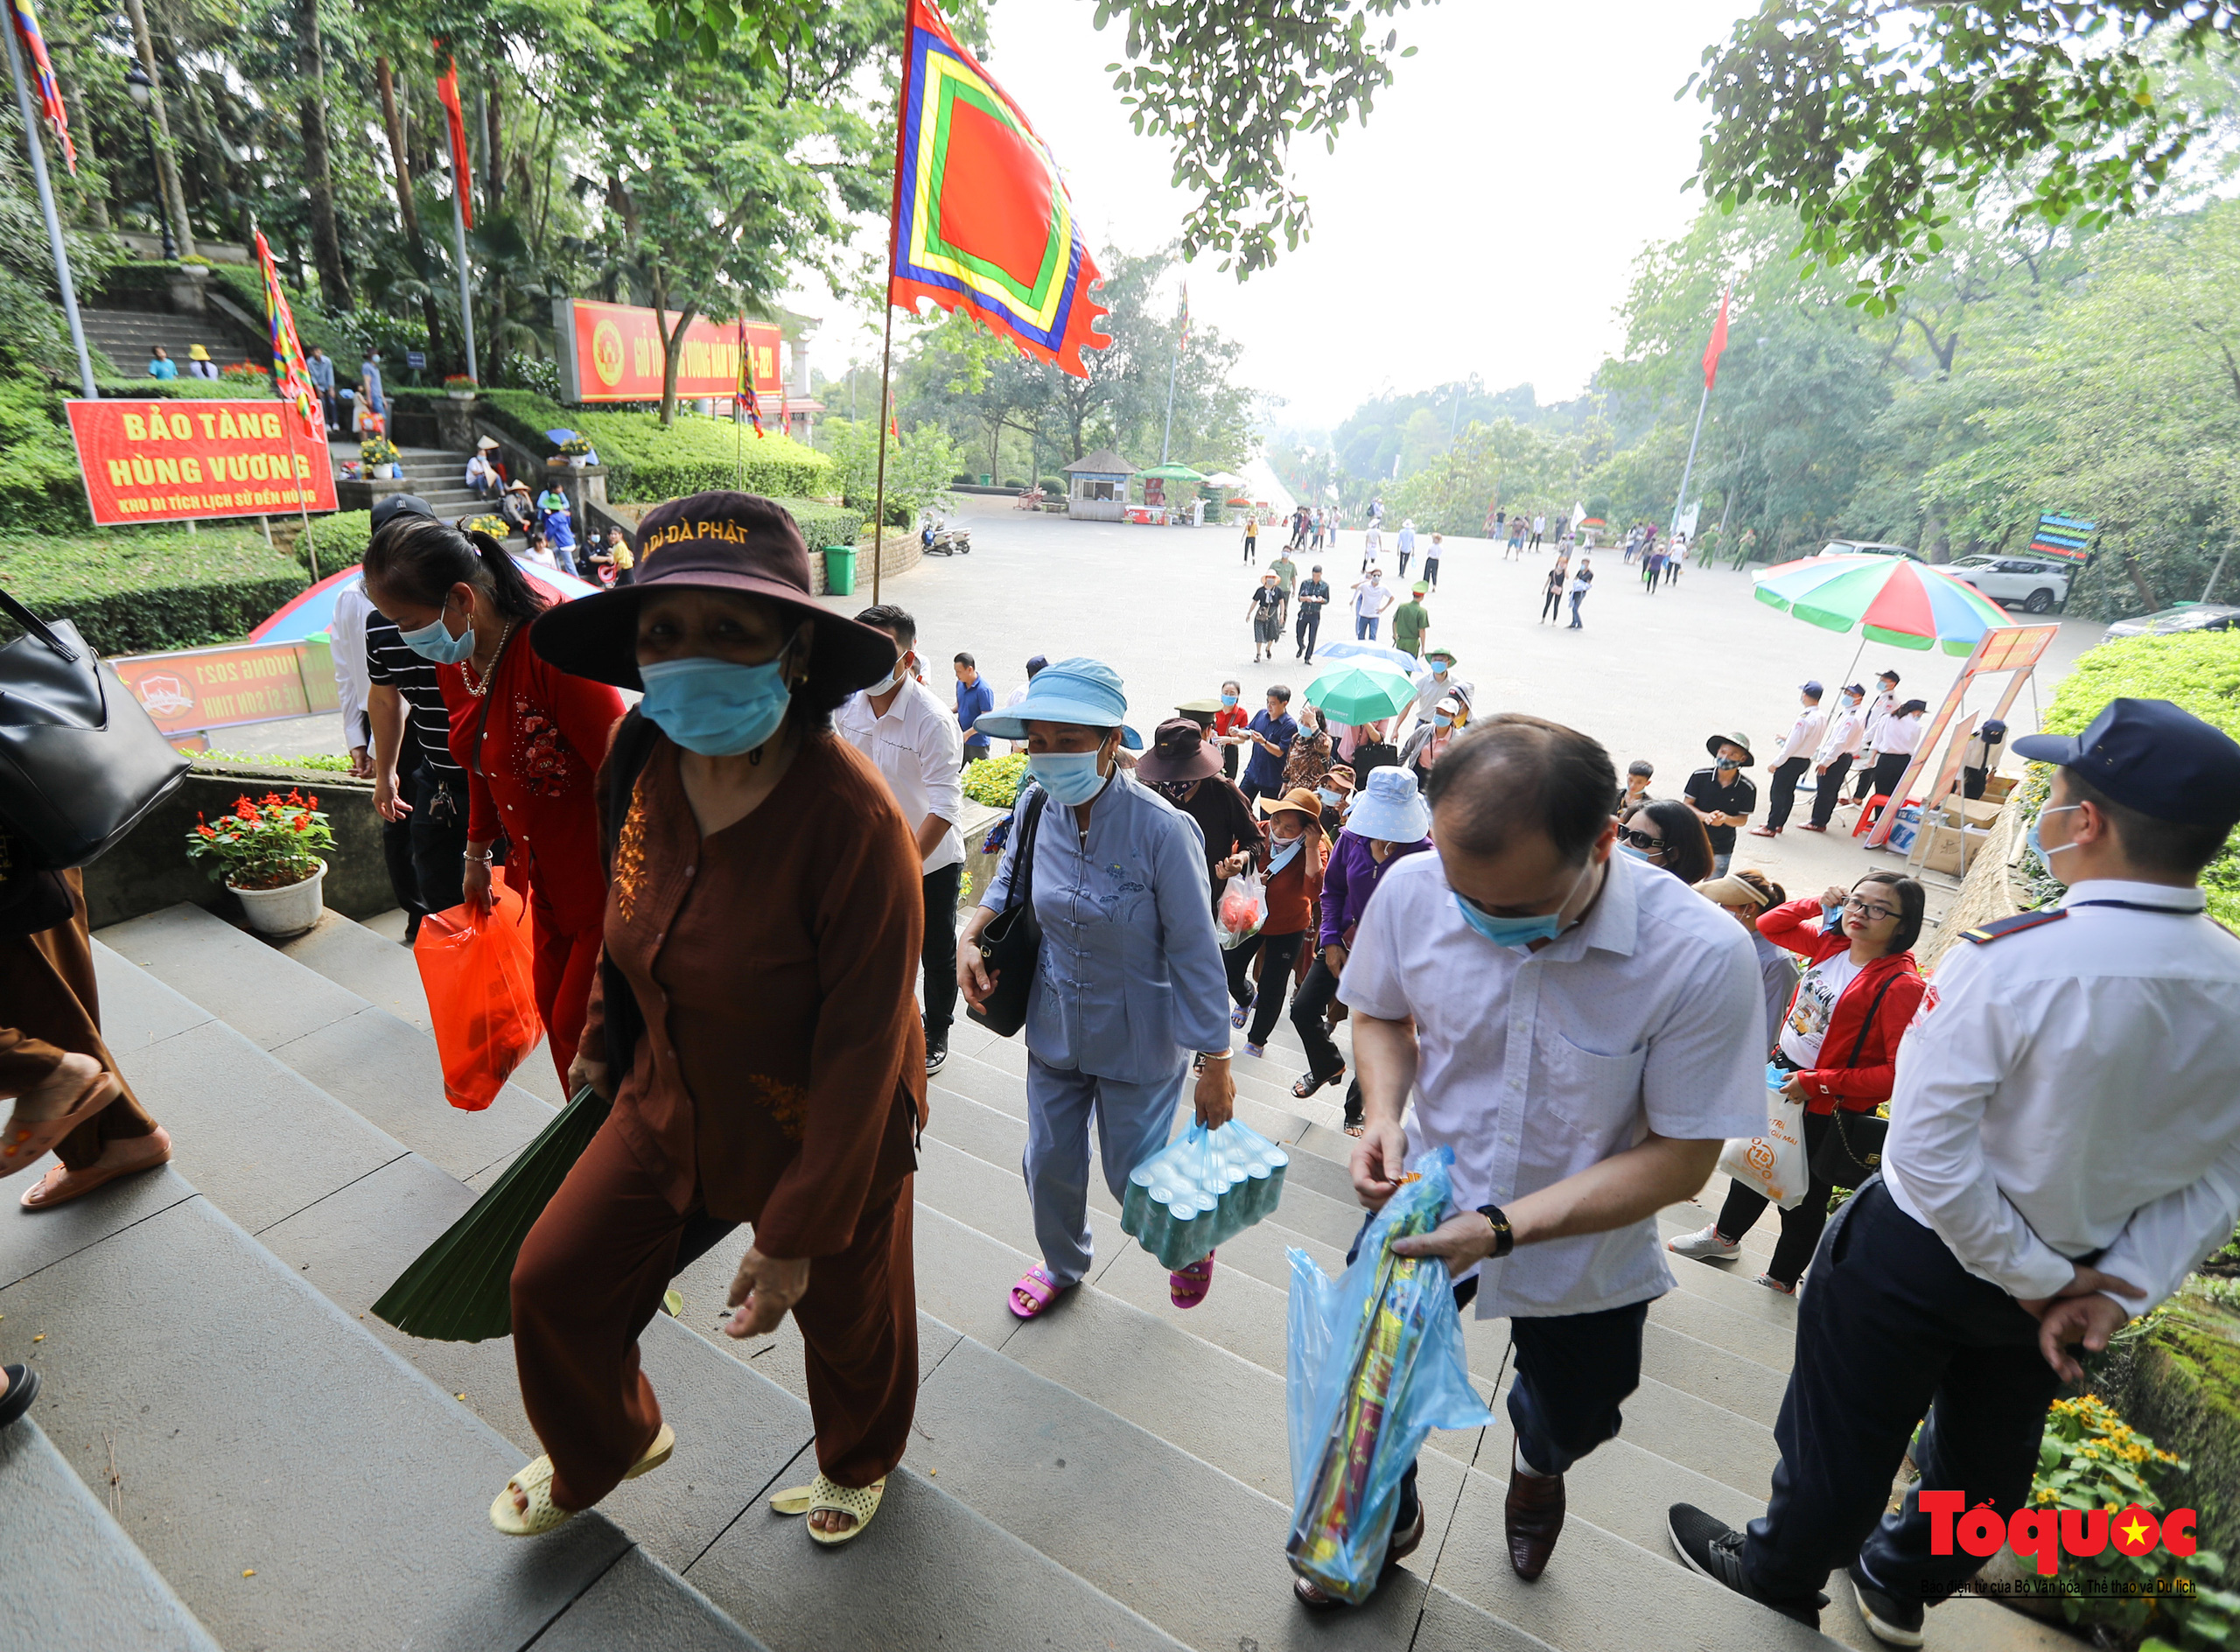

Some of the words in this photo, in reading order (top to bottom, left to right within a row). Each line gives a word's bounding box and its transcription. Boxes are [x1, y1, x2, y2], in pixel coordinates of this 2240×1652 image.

[122, 404, 193, 441] BẢO
[198, 408, 283, 440] TÀNG
[108, 453, 204, 486] HÙNG
[206, 452, 312, 482] VƯƠNG
[118, 498, 150, 514] KHU
[151, 496, 167, 512] DI
[168, 494, 201, 511] TÍCH
[201, 494, 234, 511] LỊCH
[697, 519, 748, 544] PHẬT
[1754, 1149, 1770, 1162] 15
